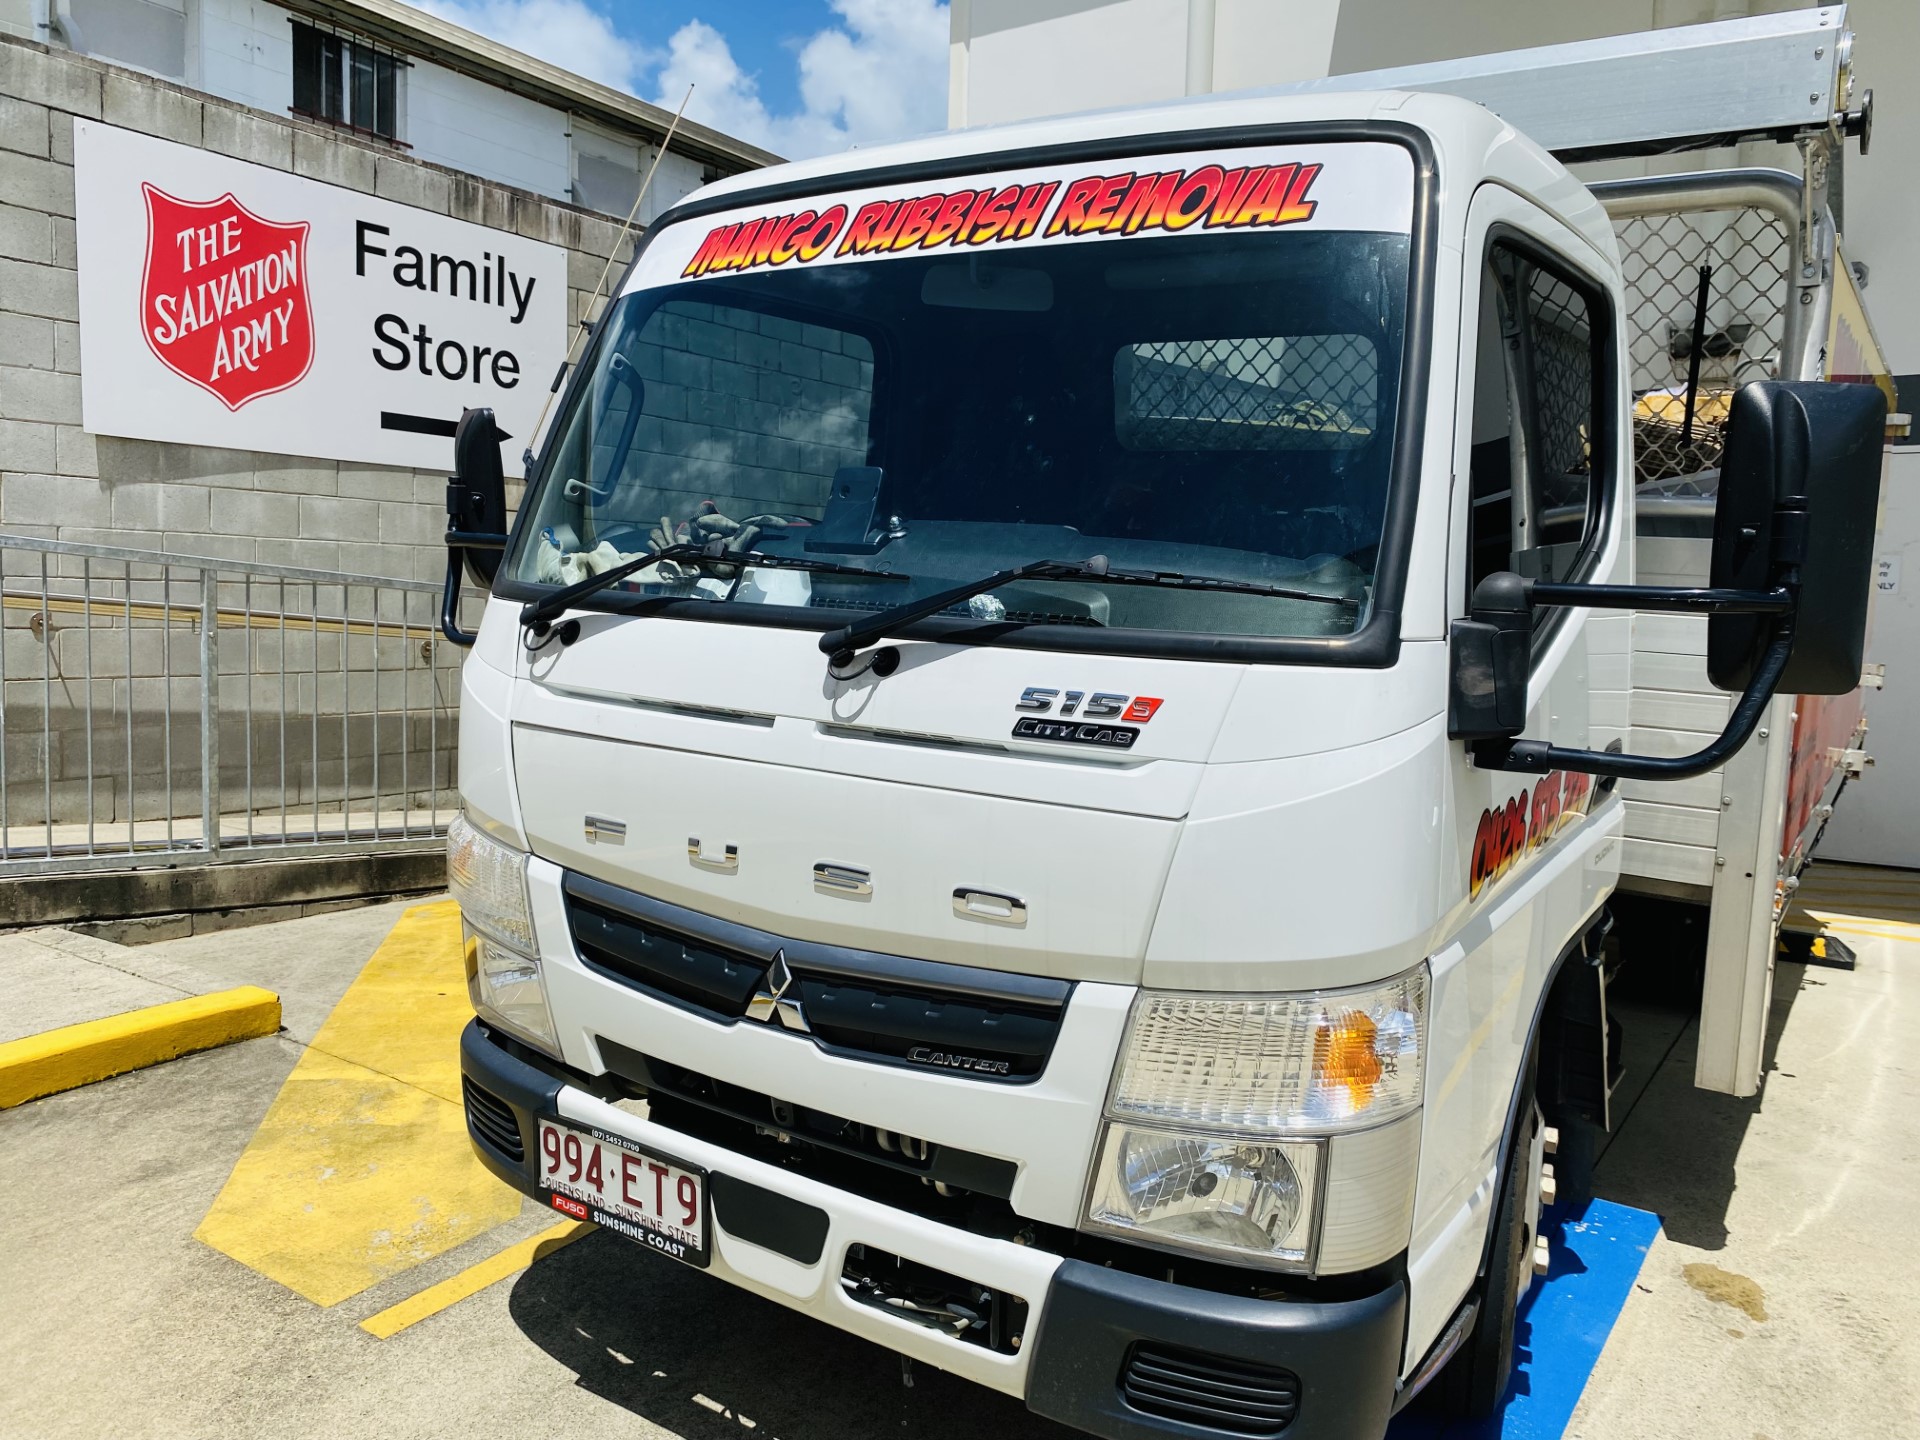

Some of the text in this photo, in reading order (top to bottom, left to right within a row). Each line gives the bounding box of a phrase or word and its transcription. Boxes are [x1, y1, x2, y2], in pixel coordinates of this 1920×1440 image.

[175, 216, 242, 274] THE
[680, 162, 1325, 279] MANGO RUBBISH REMOVAL
[153, 239, 299, 346] SALVATION
[355, 219, 537, 324] Family
[209, 299, 294, 383] ARMY
[372, 313, 521, 389] Store
[1469, 787, 1529, 904] 0426
[906, 1046, 1010, 1074] CANTER
[546, 1176, 605, 1209] QUEENSLAND
[615, 1203, 663, 1233] SUNSHINE
[667, 1225, 699, 1247] STATE
[555, 1198, 585, 1216] FUSO
[593, 1210, 686, 1258] SUNSHINE COAST
